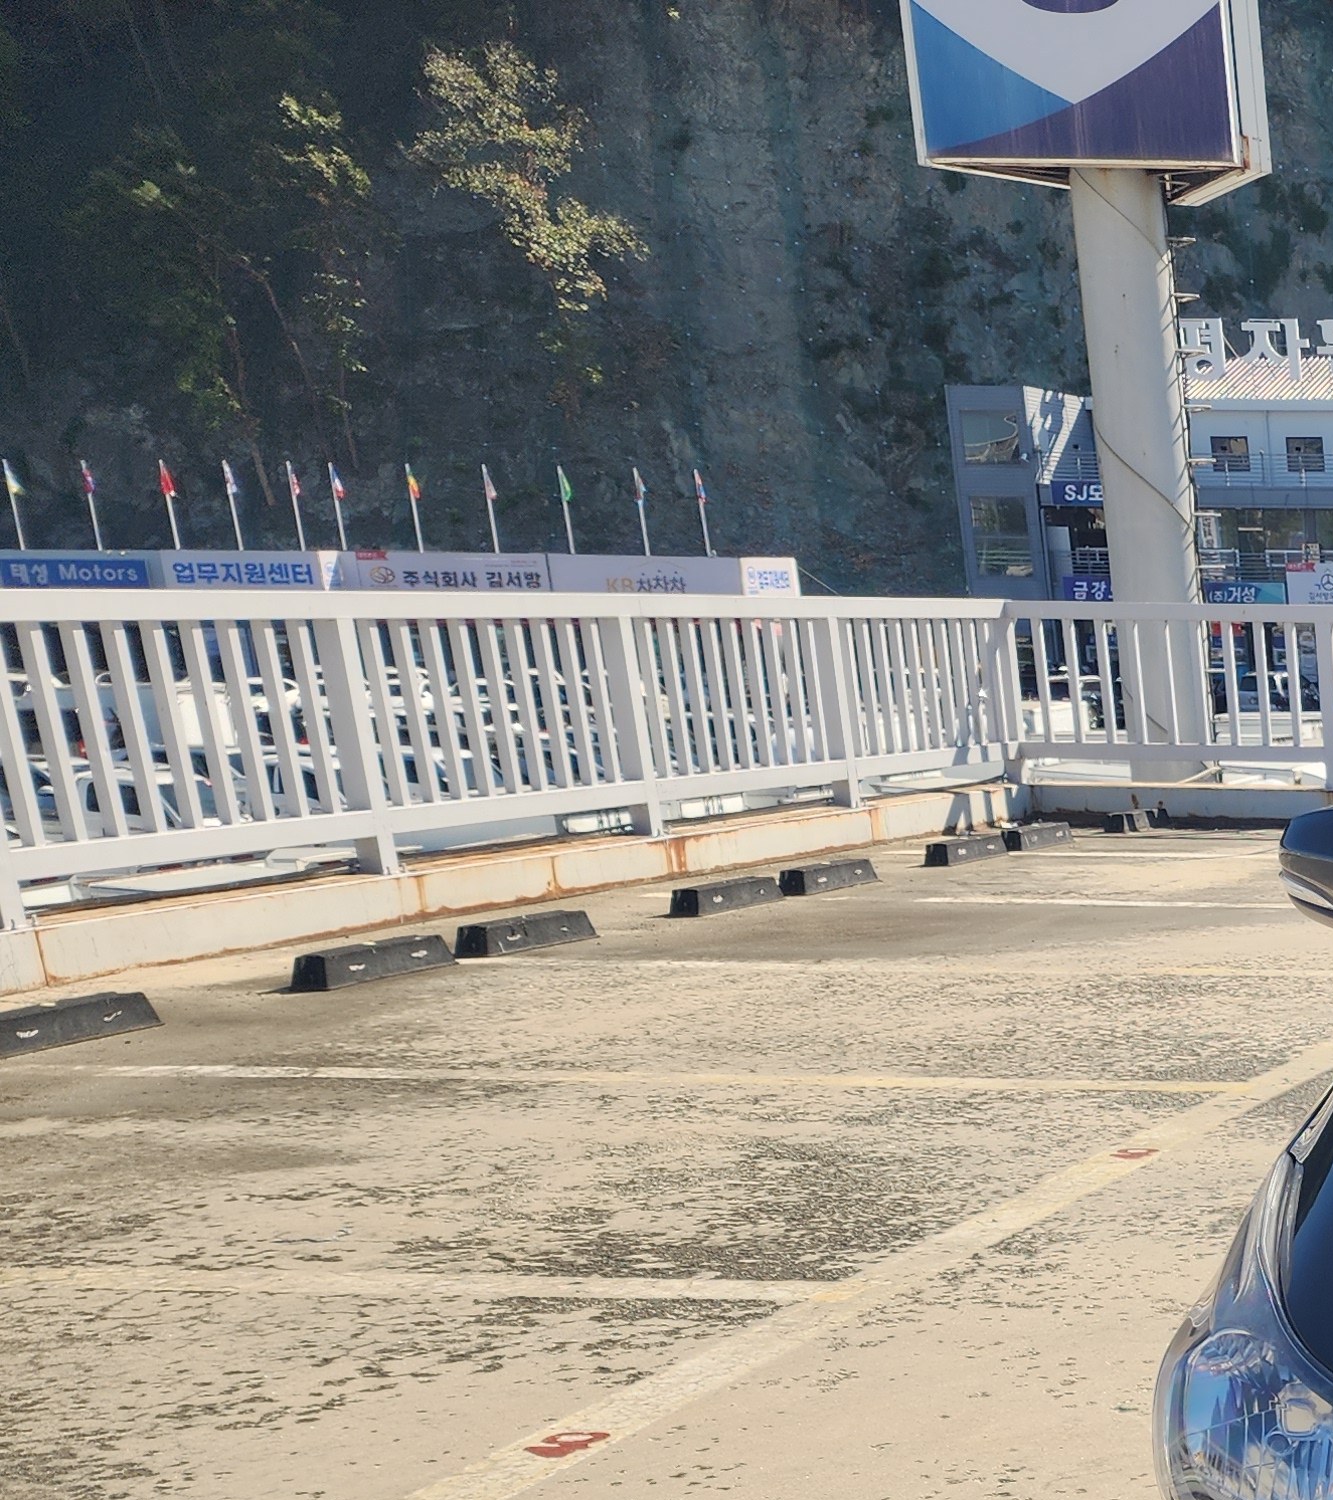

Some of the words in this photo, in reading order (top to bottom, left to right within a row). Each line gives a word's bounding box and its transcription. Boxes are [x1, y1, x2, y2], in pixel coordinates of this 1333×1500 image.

[57, 563, 138, 582] Motors
[172, 562, 314, 585] 업무지원센터
[402, 570, 477, 588] 주식회사
[486, 571, 541, 588] 김서방
[1073, 581, 1114, 600] 금강
[1209, 587, 1256, 603] (주)거성
